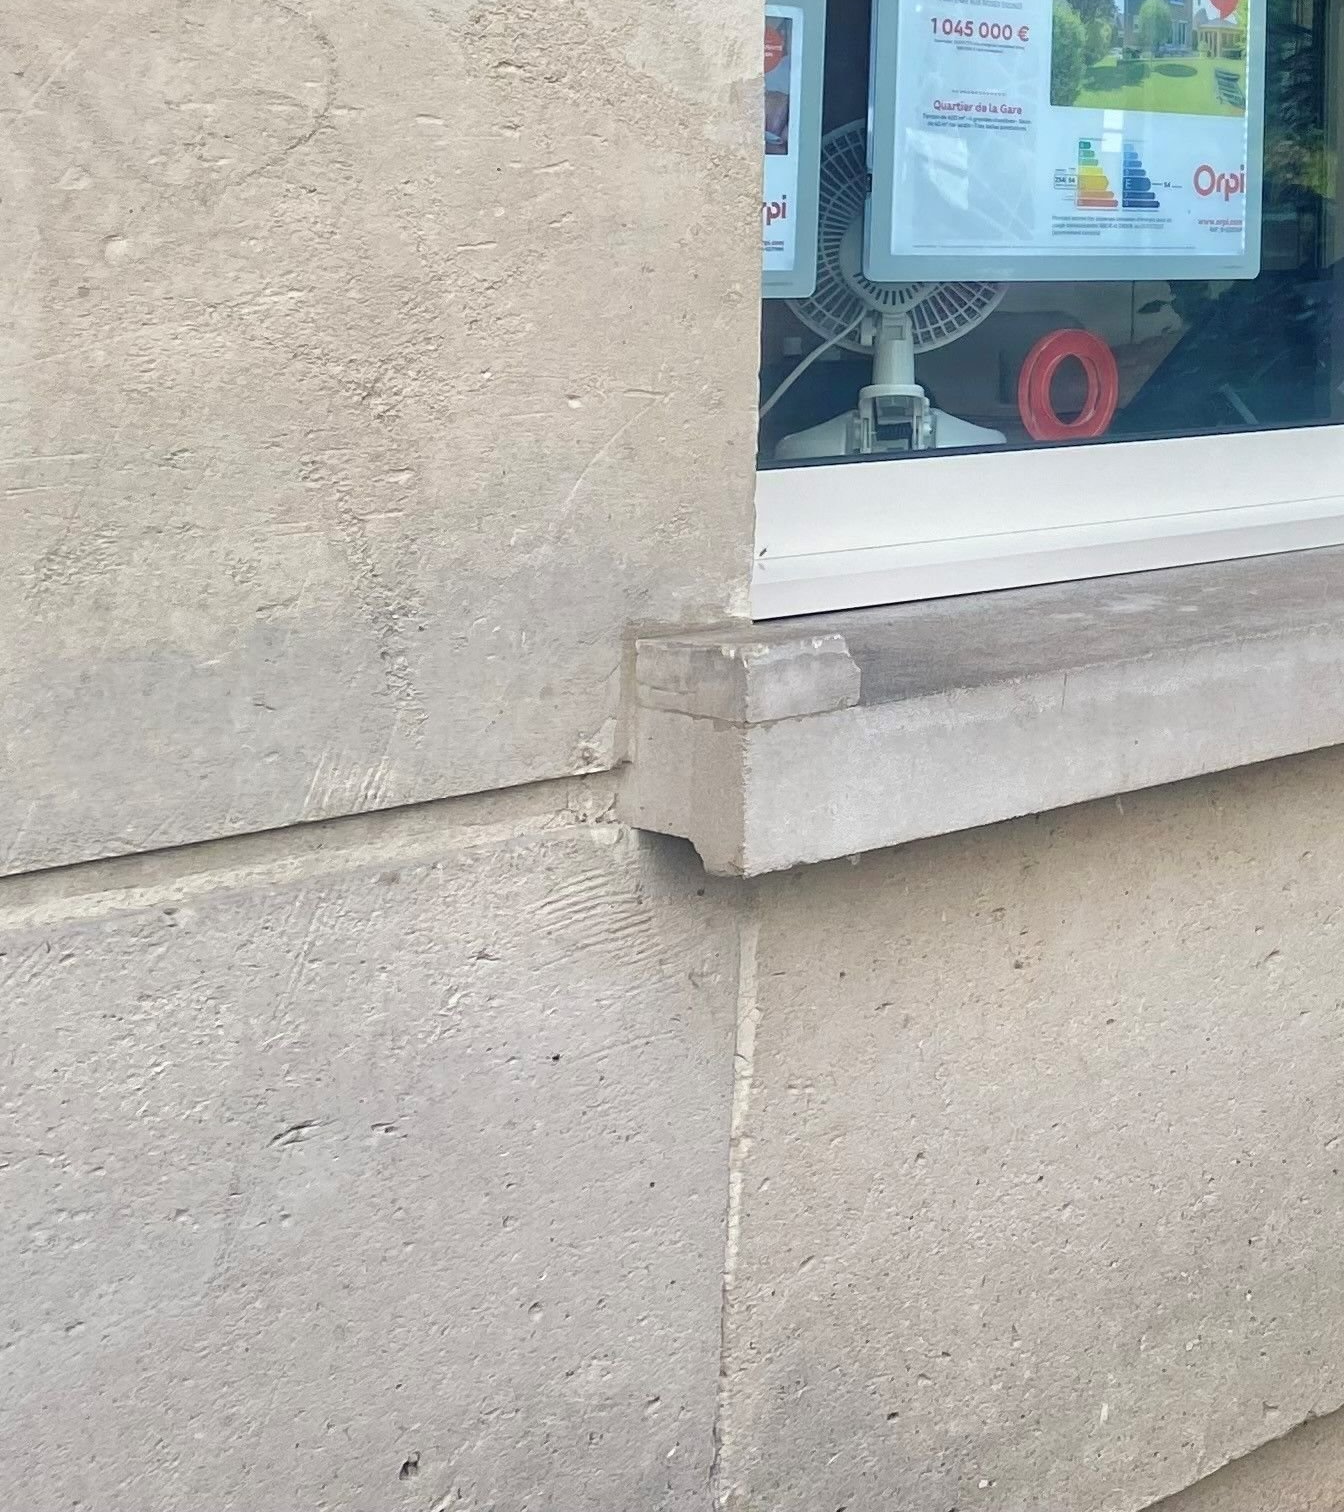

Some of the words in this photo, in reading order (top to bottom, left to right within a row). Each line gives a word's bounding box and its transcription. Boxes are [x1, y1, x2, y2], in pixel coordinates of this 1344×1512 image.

[930, 17, 938, 34] 1
[942, 18, 974, 37] 045
[978, 21, 1013, 41] 000
[1018, 25, 1030, 43] €
[933, 99, 974, 113] Quartier
[974, 102, 987, 113] de
[988, 102, 998, 114] la
[999, 103, 1023, 116] Gare
[1193, 164, 1245, 202] Orpi
